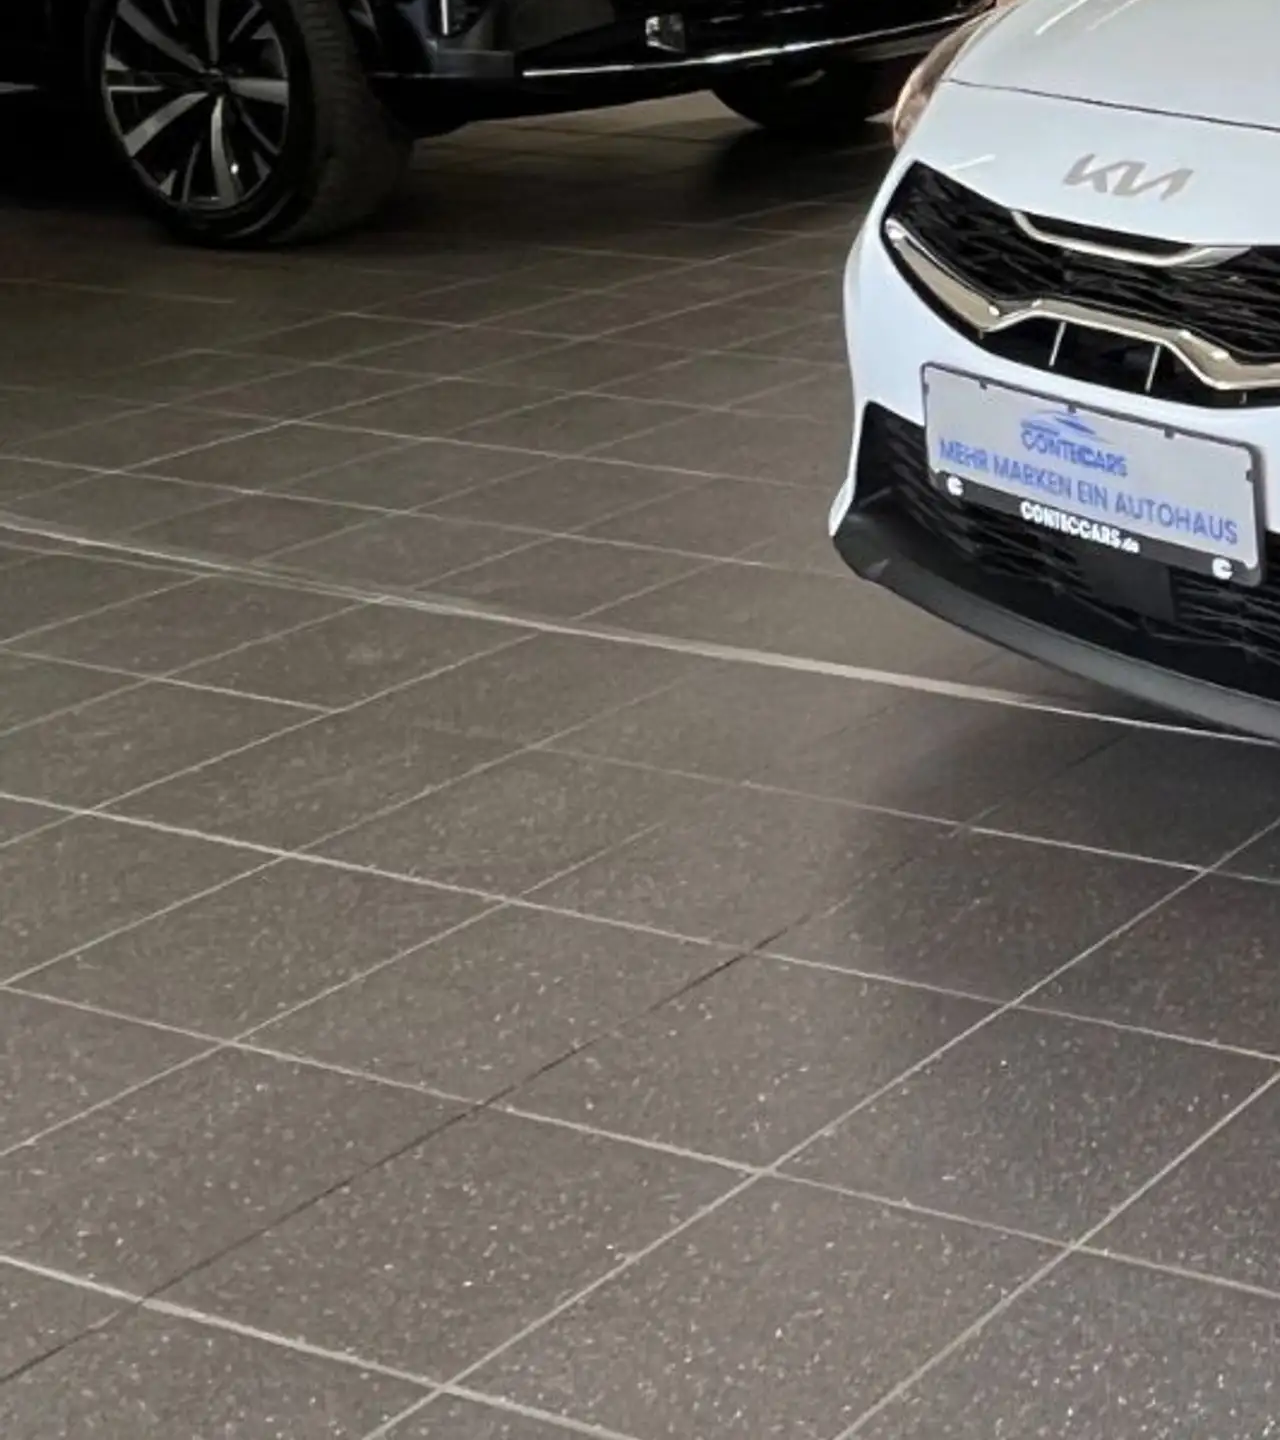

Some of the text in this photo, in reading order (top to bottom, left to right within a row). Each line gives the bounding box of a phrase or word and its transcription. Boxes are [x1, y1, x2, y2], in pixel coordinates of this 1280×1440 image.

[1063, 153, 1194, 201] KIA
[939, 438, 1239, 545] MEHR MARKEN EIN AUTOHAUS
